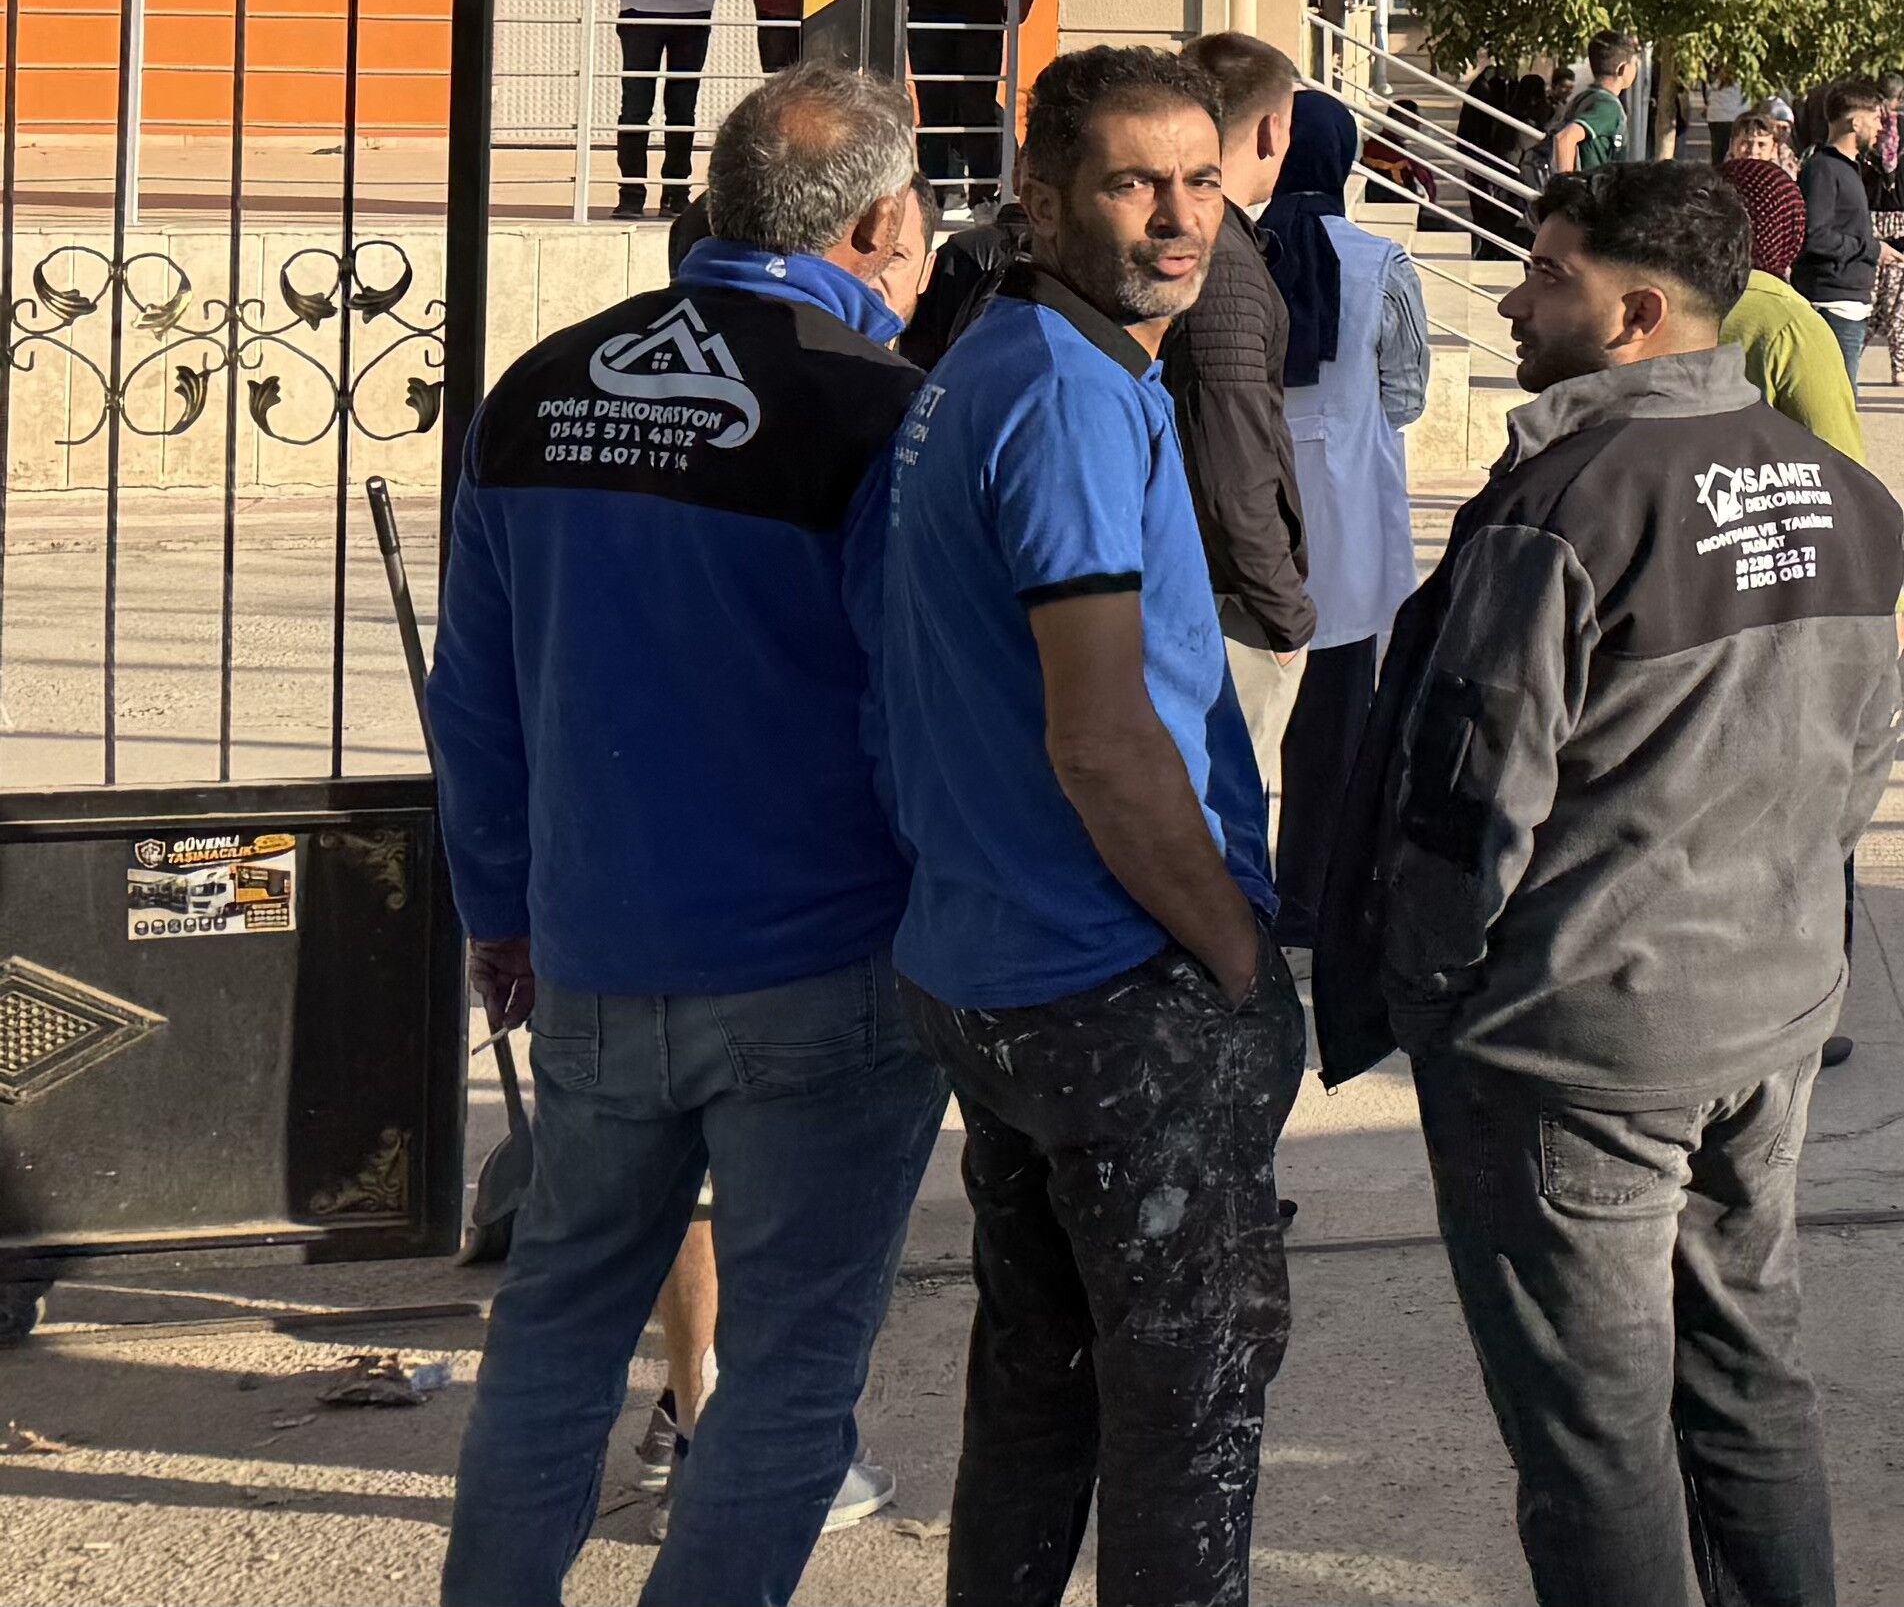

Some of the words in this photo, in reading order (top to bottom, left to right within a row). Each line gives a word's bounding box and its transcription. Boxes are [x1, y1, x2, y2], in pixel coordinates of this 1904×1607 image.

[537, 397, 589, 418] DOĞA
[594, 399, 722, 430] DEKORASYON
[550, 422, 595, 438] 0545
[603, 423, 640, 442] 571
[544, 445, 593, 462] 0538
[599, 447, 641, 466] 607
[1743, 462, 1821, 493] SAMET
